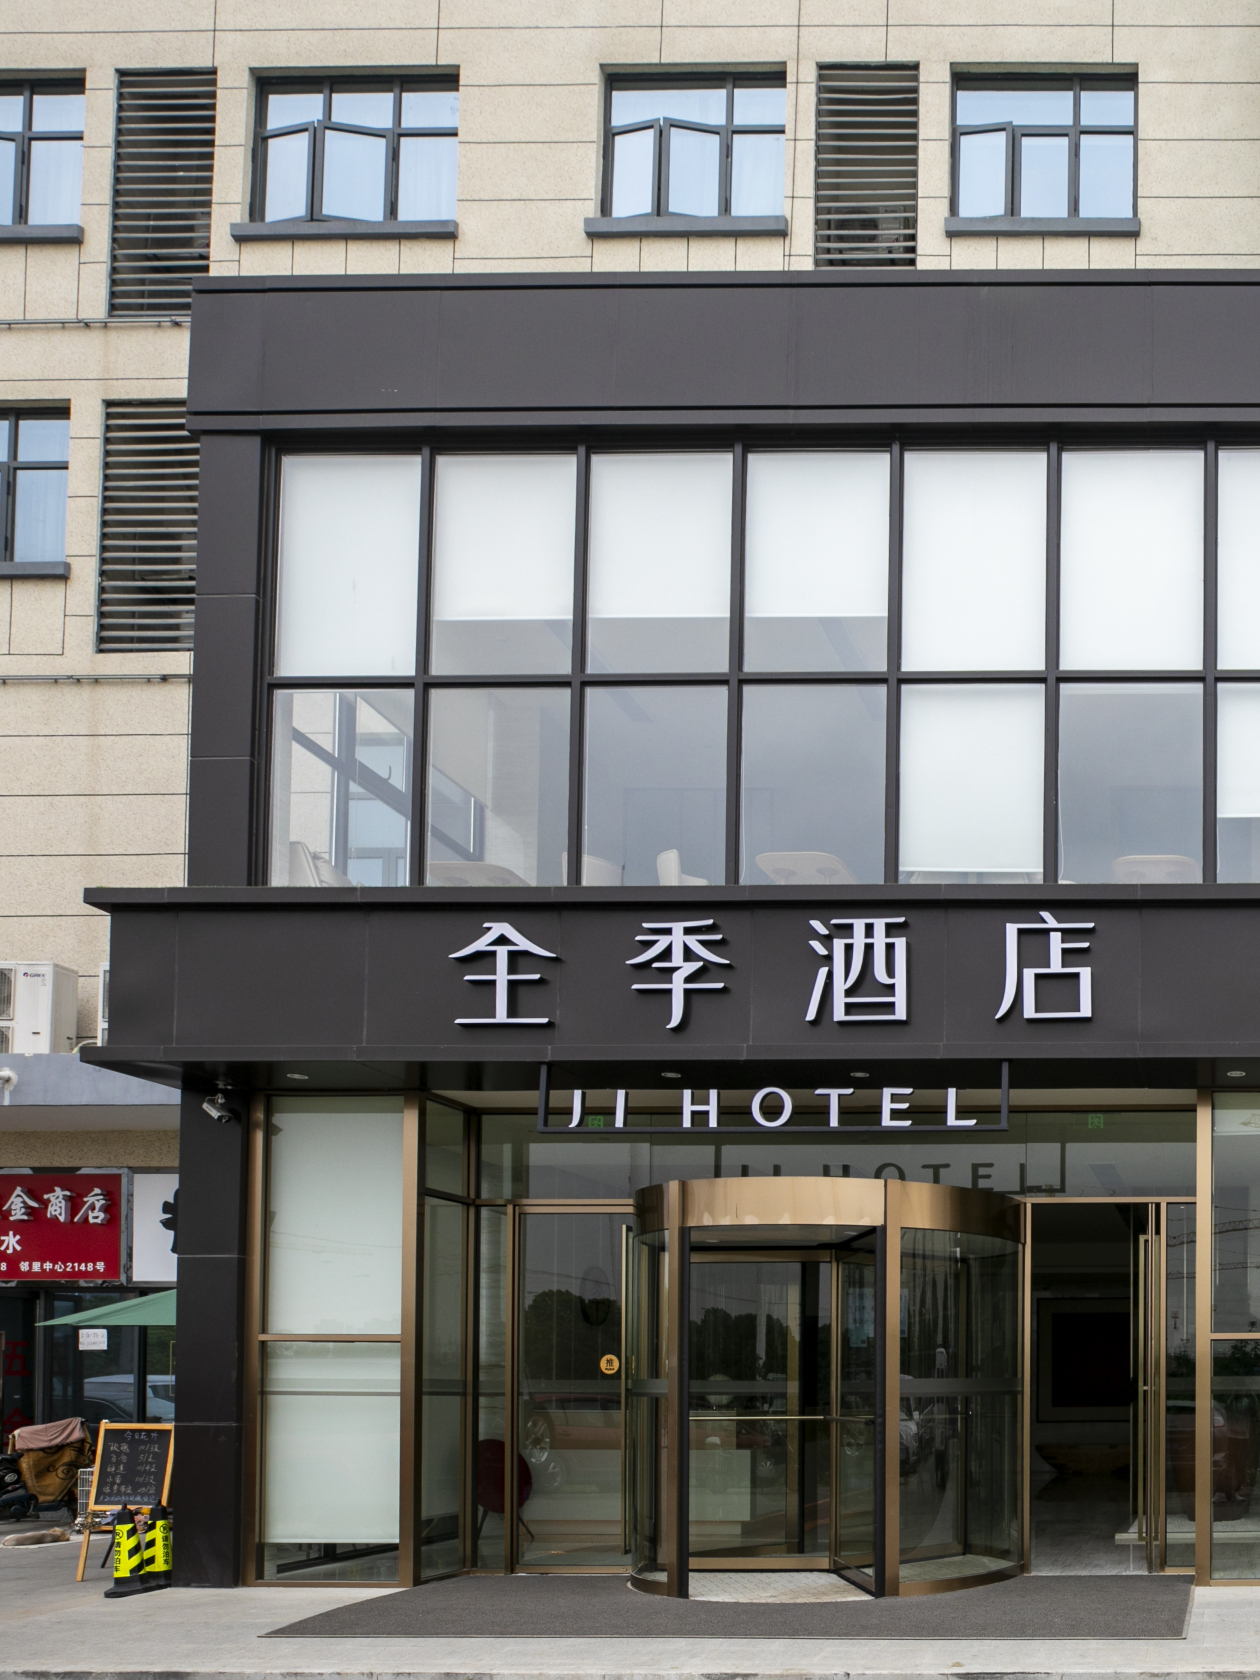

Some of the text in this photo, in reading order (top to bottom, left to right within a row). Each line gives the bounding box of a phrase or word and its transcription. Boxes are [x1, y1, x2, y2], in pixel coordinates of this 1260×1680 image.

[448, 911, 1095, 1029] 全季酒店
[568, 1087, 977, 1128] JI HOTEL
[2, 1186, 107, 1224] 金商店
[0, 1231, 22, 1254] 水
[19, 1261, 106, 1272] 邻里中心2148号
[161, 1535, 170, 1566] 请勿泊车
